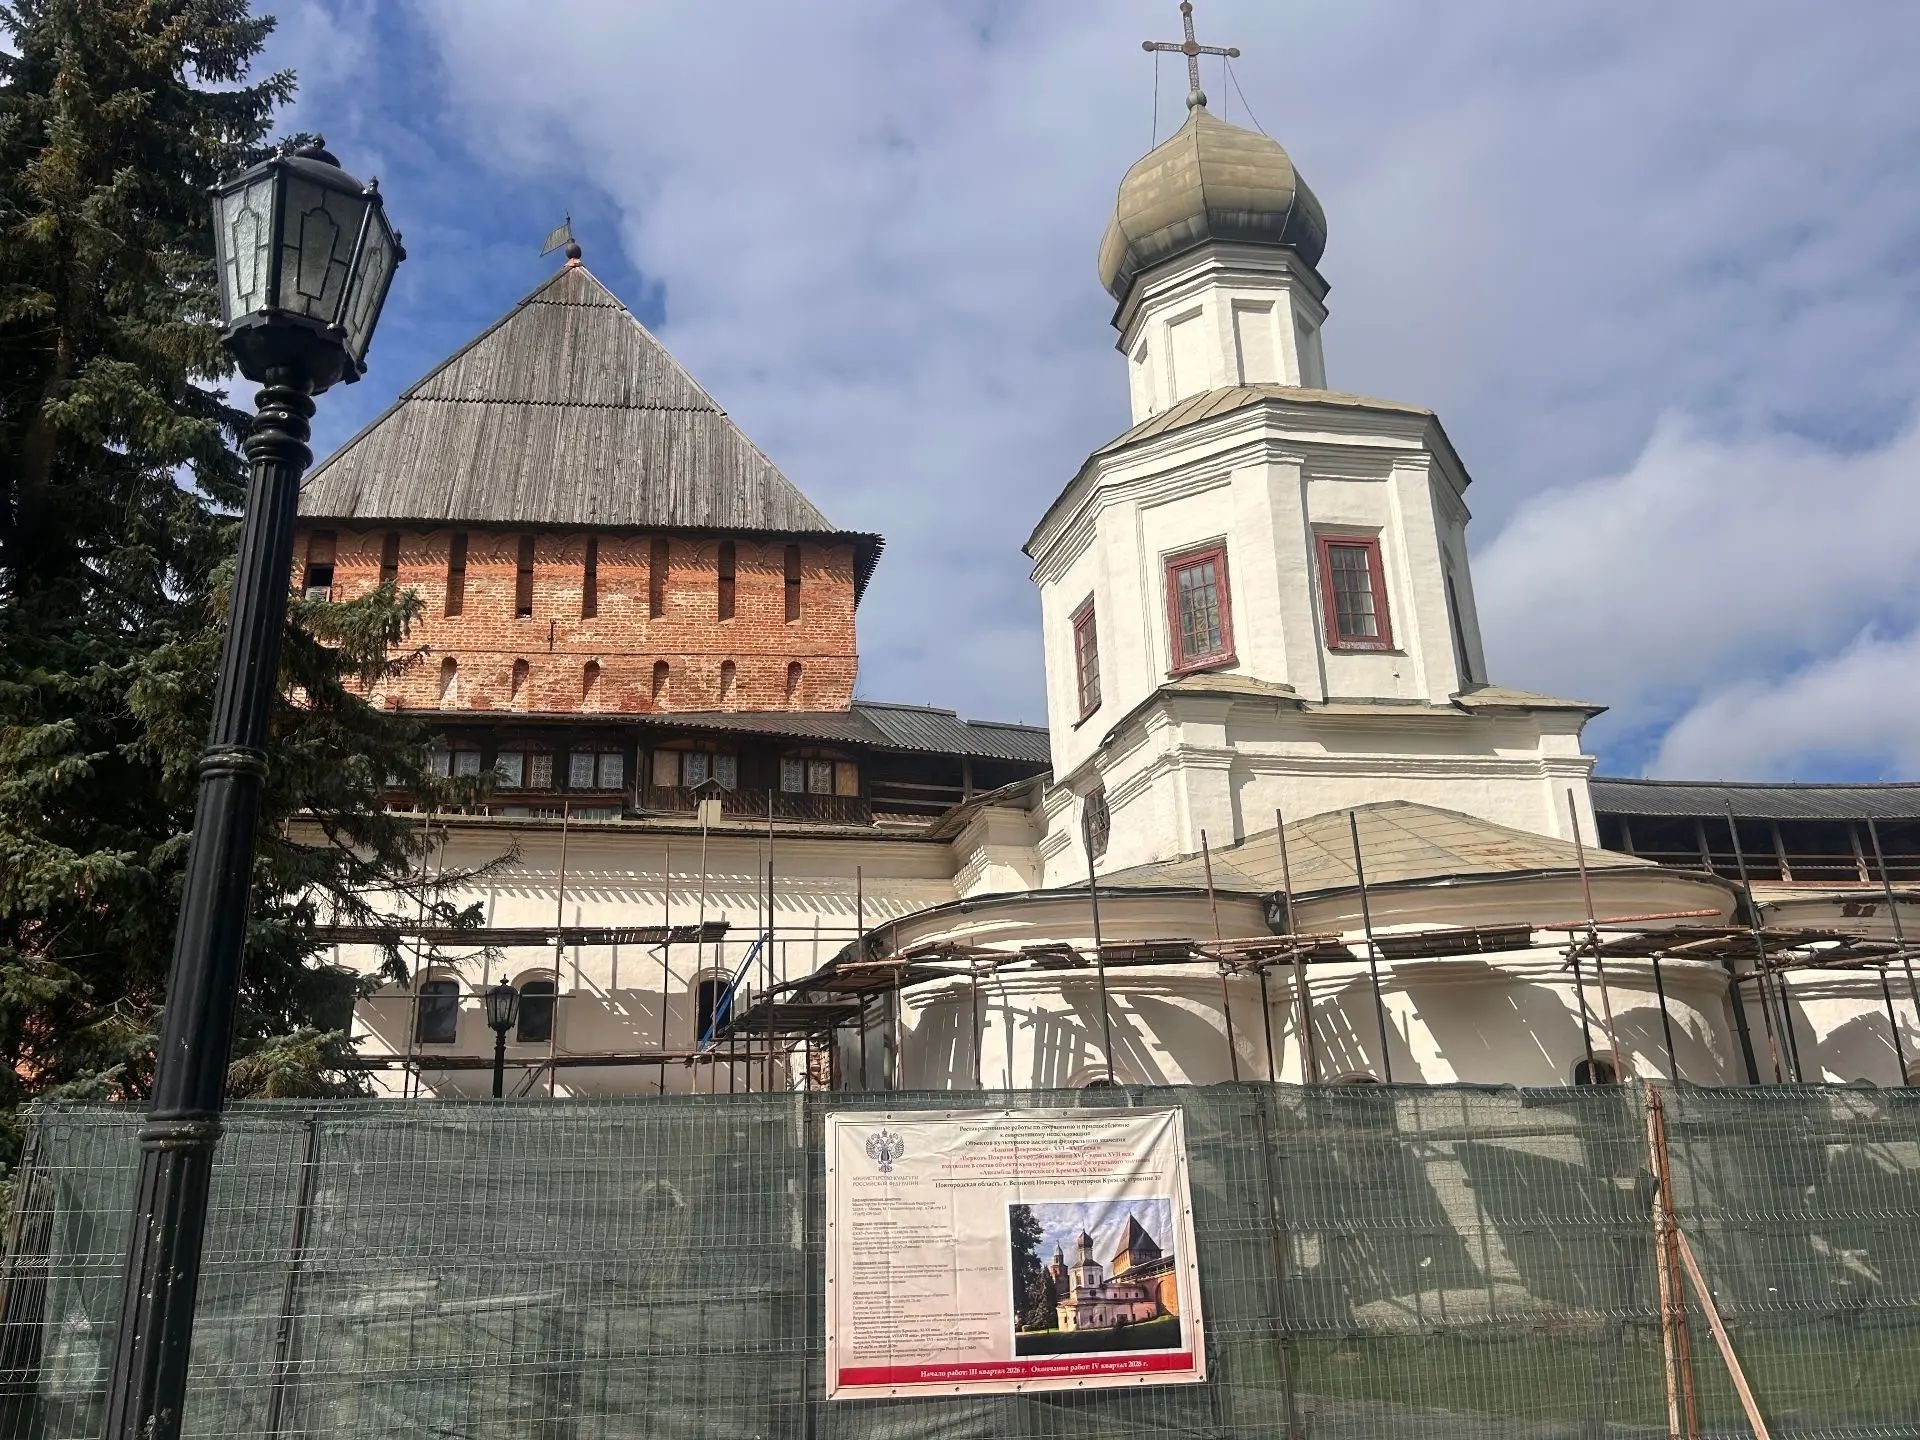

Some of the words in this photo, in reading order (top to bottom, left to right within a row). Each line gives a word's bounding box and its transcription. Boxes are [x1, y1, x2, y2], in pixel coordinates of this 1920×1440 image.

[947, 1369, 968, 1378] работ:
[979, 1368, 1005, 1376] квартал
[1070, 1363, 1090, 1372] работ:
[1101, 1361, 1127, 1370] квартал
